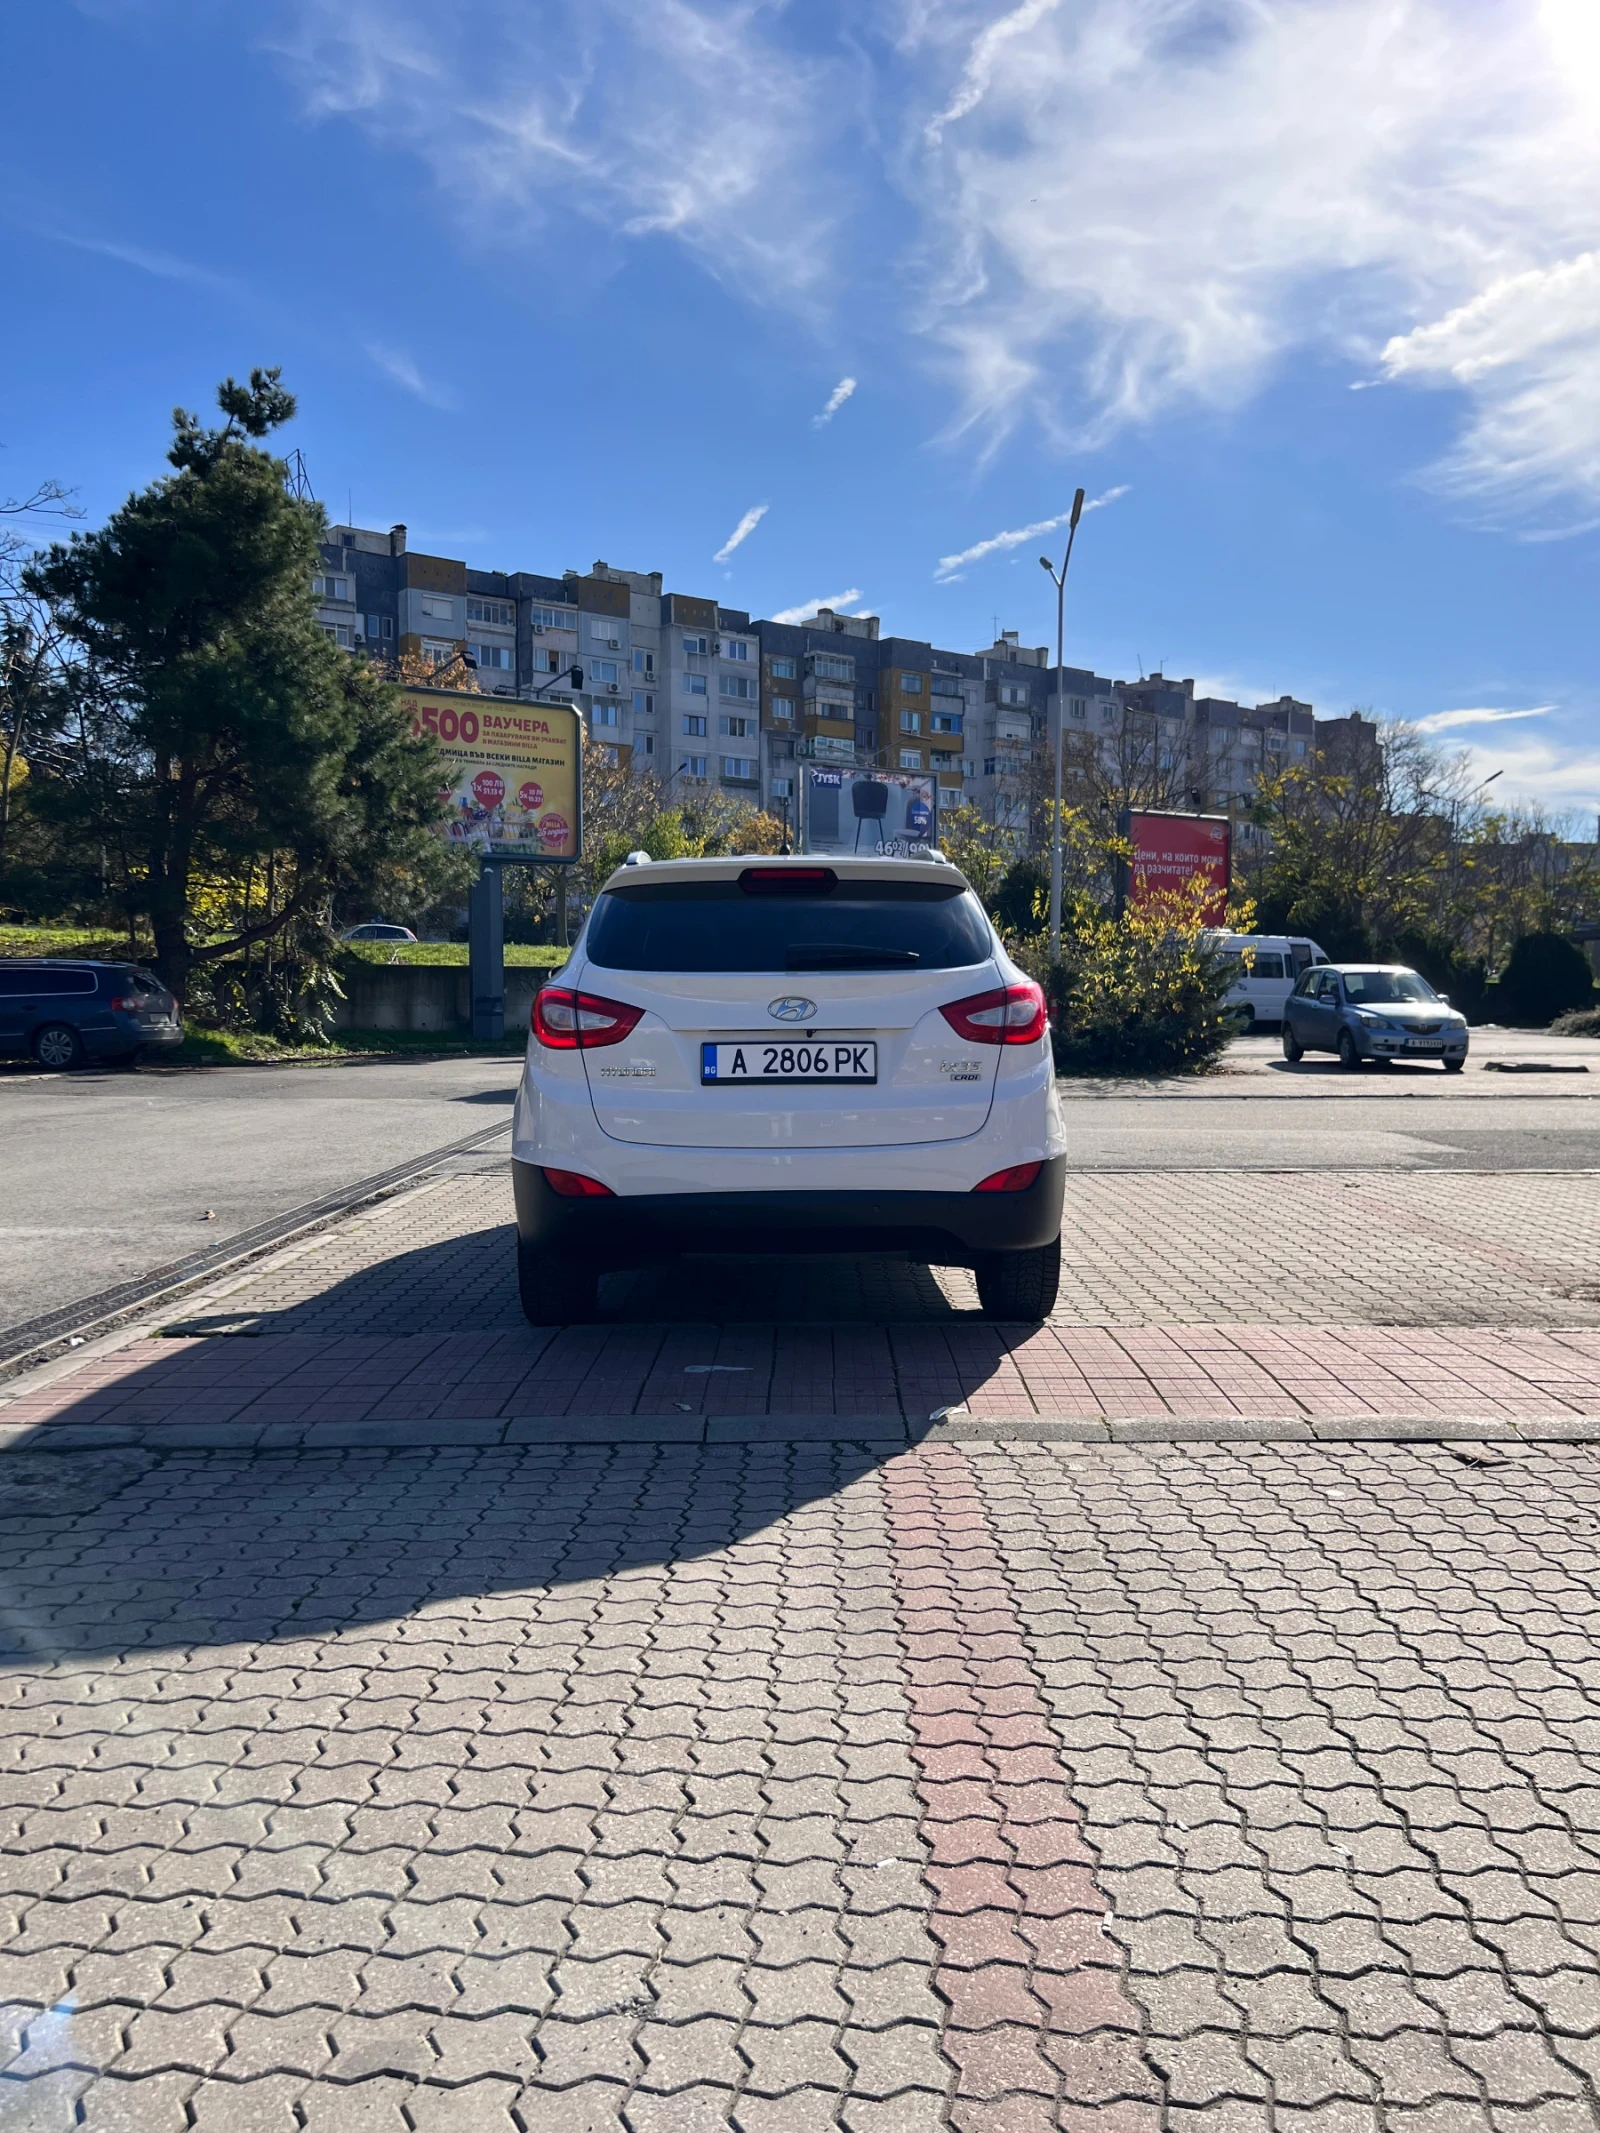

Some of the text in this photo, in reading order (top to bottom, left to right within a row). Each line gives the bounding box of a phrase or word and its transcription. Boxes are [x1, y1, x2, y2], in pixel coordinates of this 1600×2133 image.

[401, 699, 418, 707] НАД
[482, 715, 550, 734] ВАУЧЕРА
[491, 732, 530, 741] ПАЗАРУВАНЕ
[487, 739, 521, 747] МАГАЗИНИ
[469, 751, 485, 759] ВЪВ
[486, 753, 510, 761] ВСЕКИ
[511, 756, 531, 764] BILLA
[532, 757, 565, 766] МАГАЗИН
[817, 773, 841, 785] JYSK
[1134, 849, 1224, 865] Цени, на които може
[1134, 864, 1193, 876] да разчитате!
[731, 1047, 869, 1074] A 2806 PK
[600, 1066, 656, 1077] HYUNDAI
[704, 1066, 716, 1074] BG
